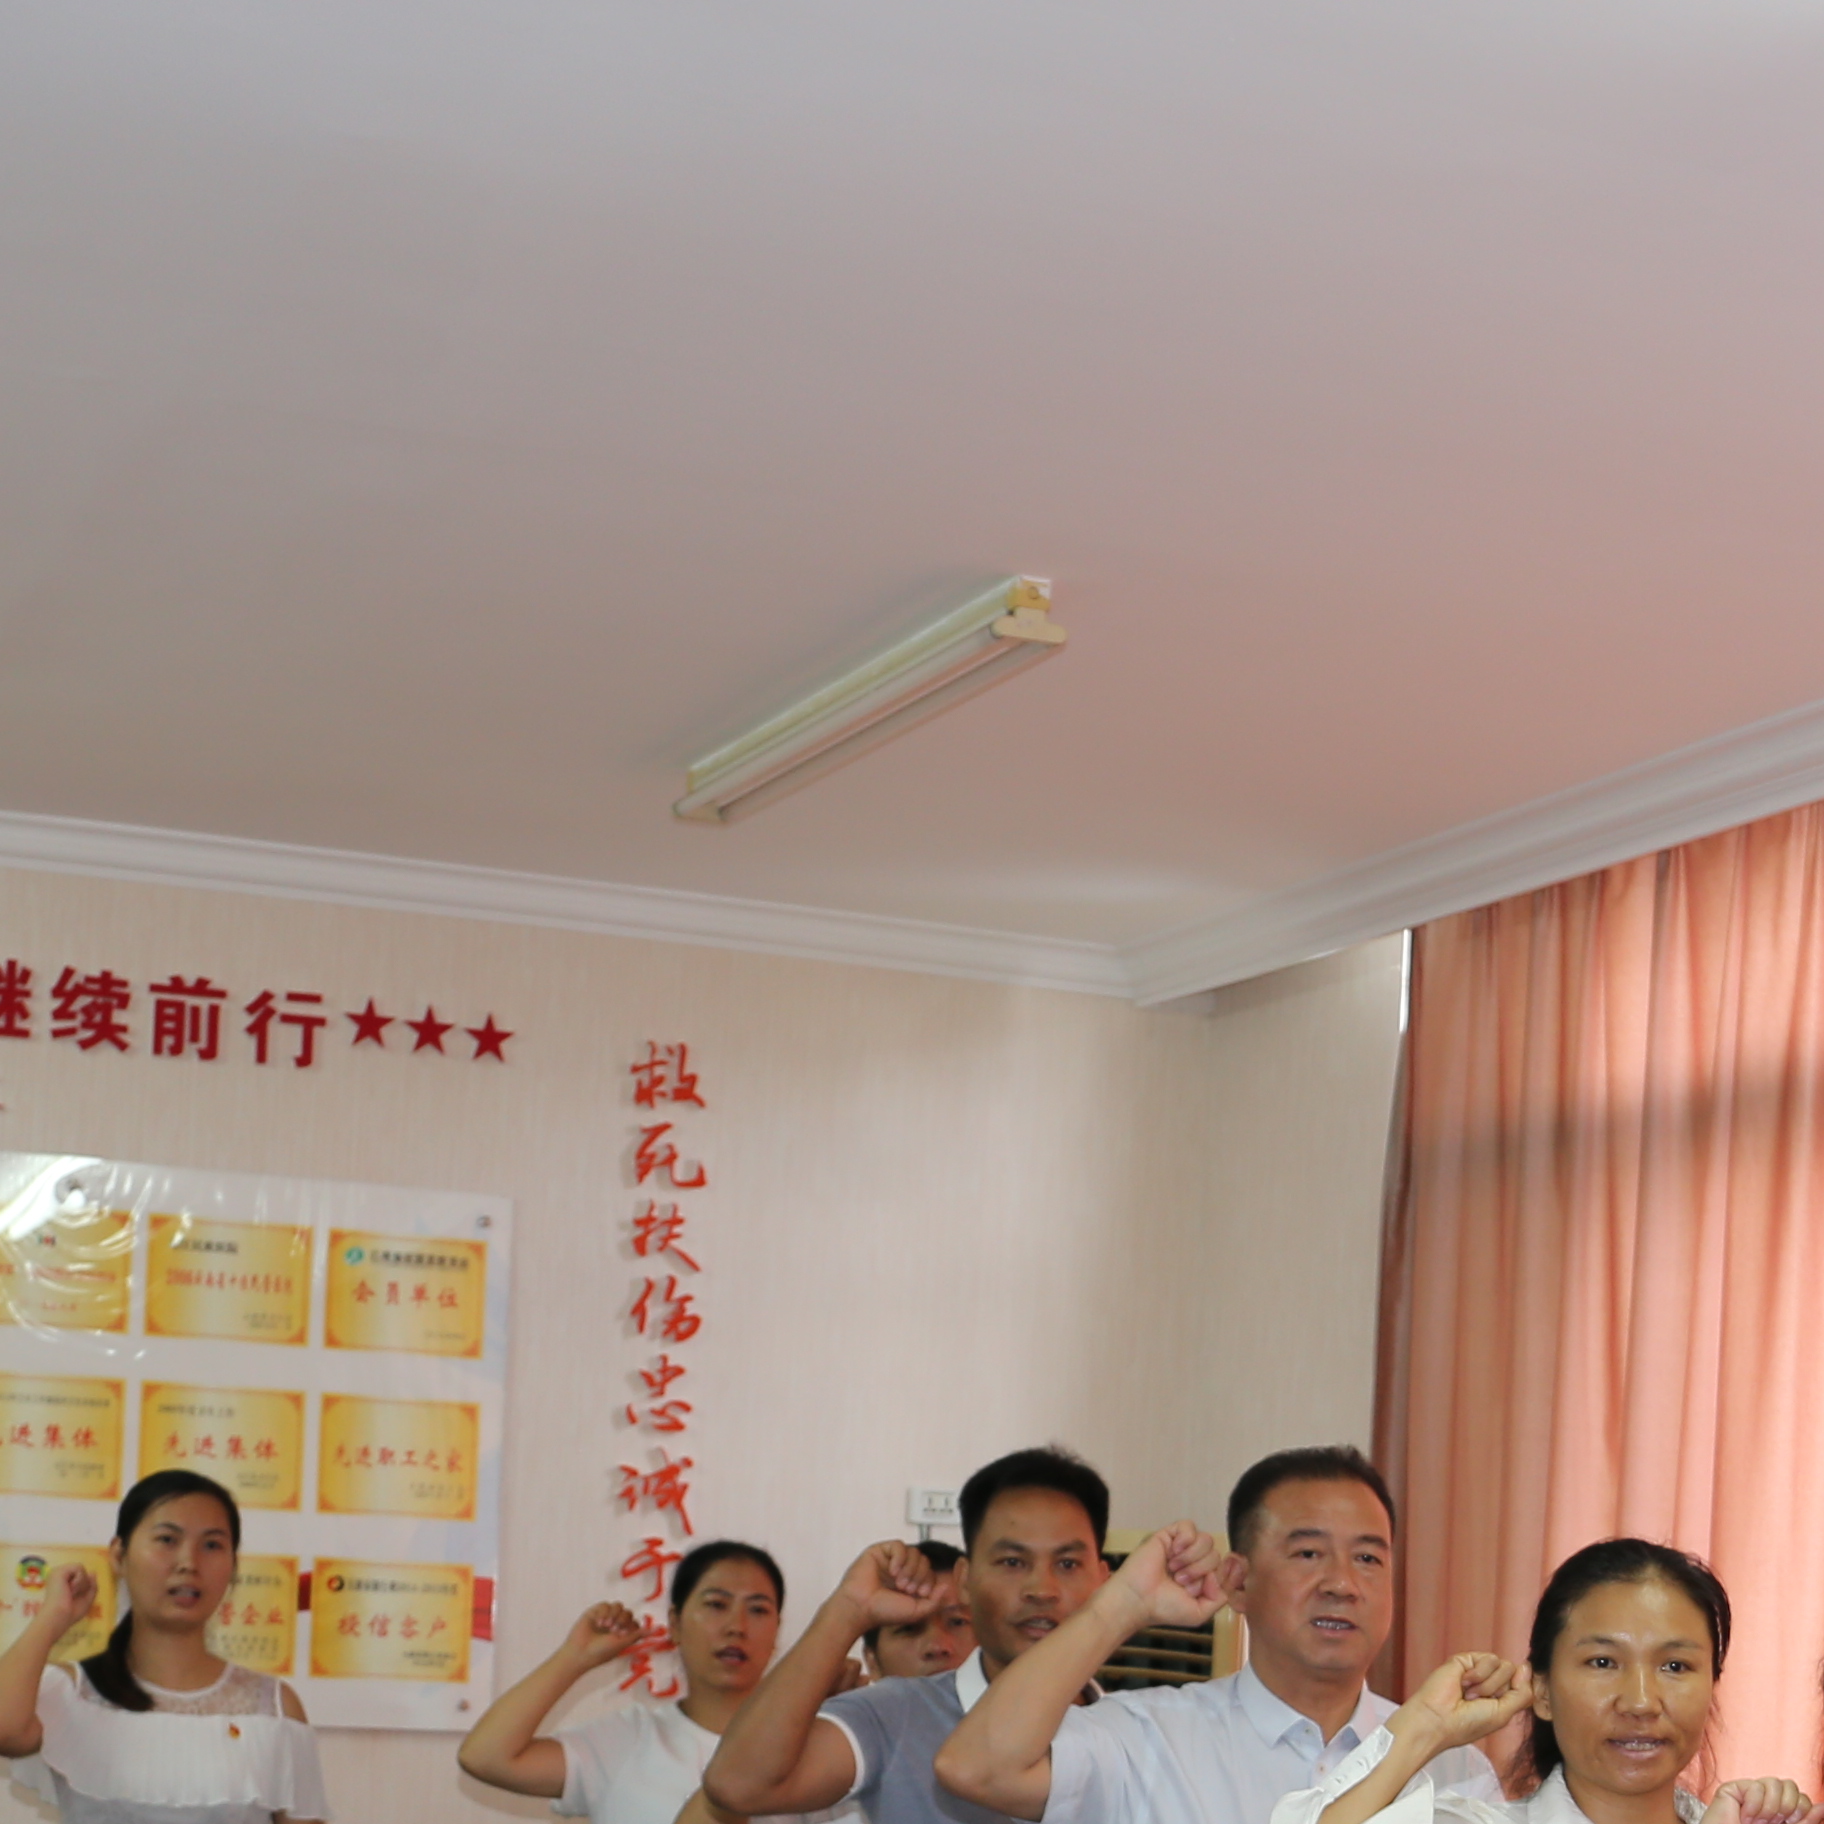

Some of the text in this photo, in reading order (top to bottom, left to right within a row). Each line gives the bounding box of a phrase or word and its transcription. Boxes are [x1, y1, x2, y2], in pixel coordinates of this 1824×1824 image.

[351, 1278, 460, 1310] 会员单位
[162, 1430, 280, 1461] 先进集体
